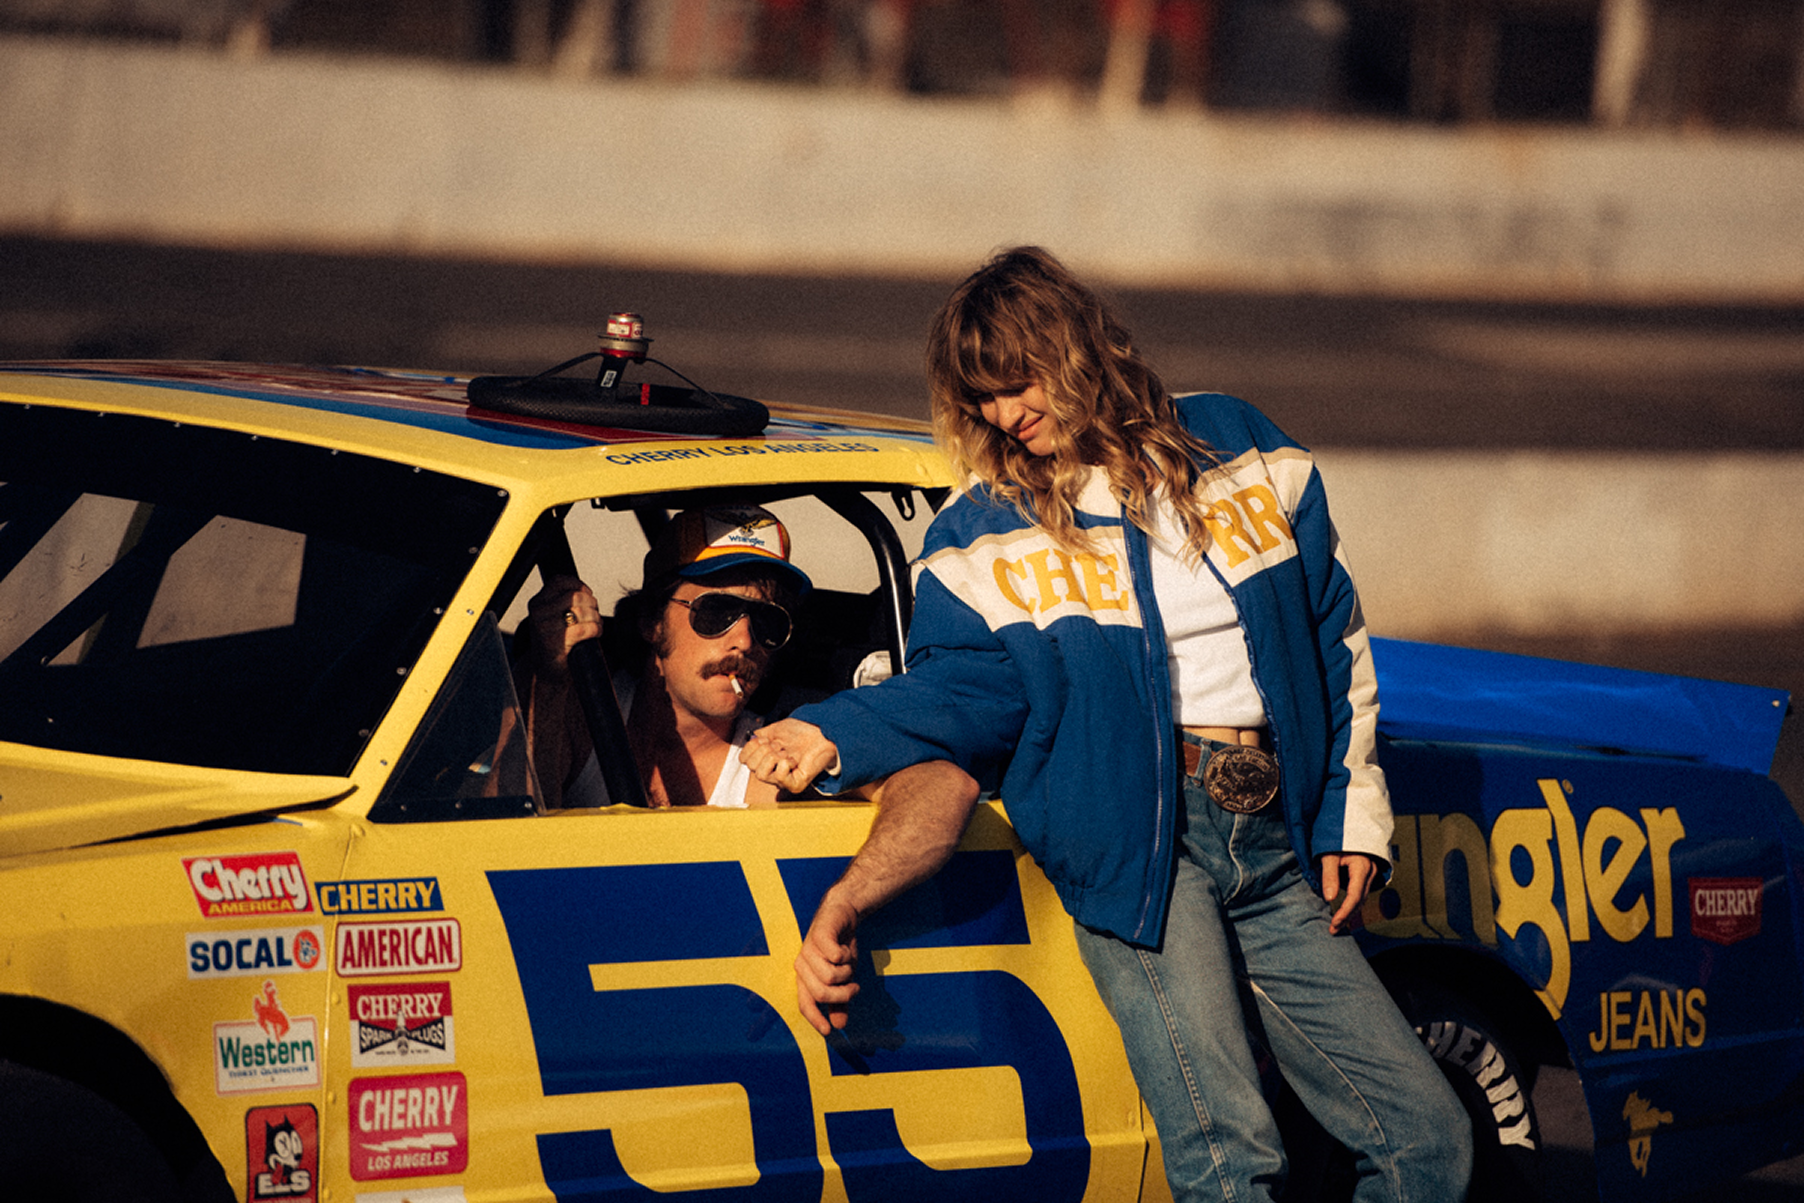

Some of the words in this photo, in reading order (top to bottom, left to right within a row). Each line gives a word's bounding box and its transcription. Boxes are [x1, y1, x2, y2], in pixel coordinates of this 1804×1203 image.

[606, 446, 711, 465] CHERRY
[709, 445, 766, 457] LOS
[765, 443, 880, 454] ANGELES
[992, 548, 1130, 613] CHE
[1202, 477, 1294, 569] RR
[190, 858, 309, 911] Cherry
[320, 881, 435, 912] CHERRY
[1359, 778, 1686, 1021] angler
[1695, 888, 1758, 915] CHERRY
[208, 899, 292, 916] AMERICA
[190, 935, 293, 972] SOCAL
[341, 925, 454, 969] AMERICAN
[357, 992, 443, 1020] CHERRY
[1588, 988, 1707, 1052] JEANS
[361, 1026, 393, 1049] SPARK
[411, 1023, 444, 1046] PLUGS
[484, 849, 1091, 1203] 55
[219, 1036, 315, 1069] Western
[1415, 1021, 1535, 1150] HERRY
[358, 1085, 458, 1132] CHERRY
[367, 1156, 391, 1171] LOS
[393, 1151, 449, 1169] ANGELES
